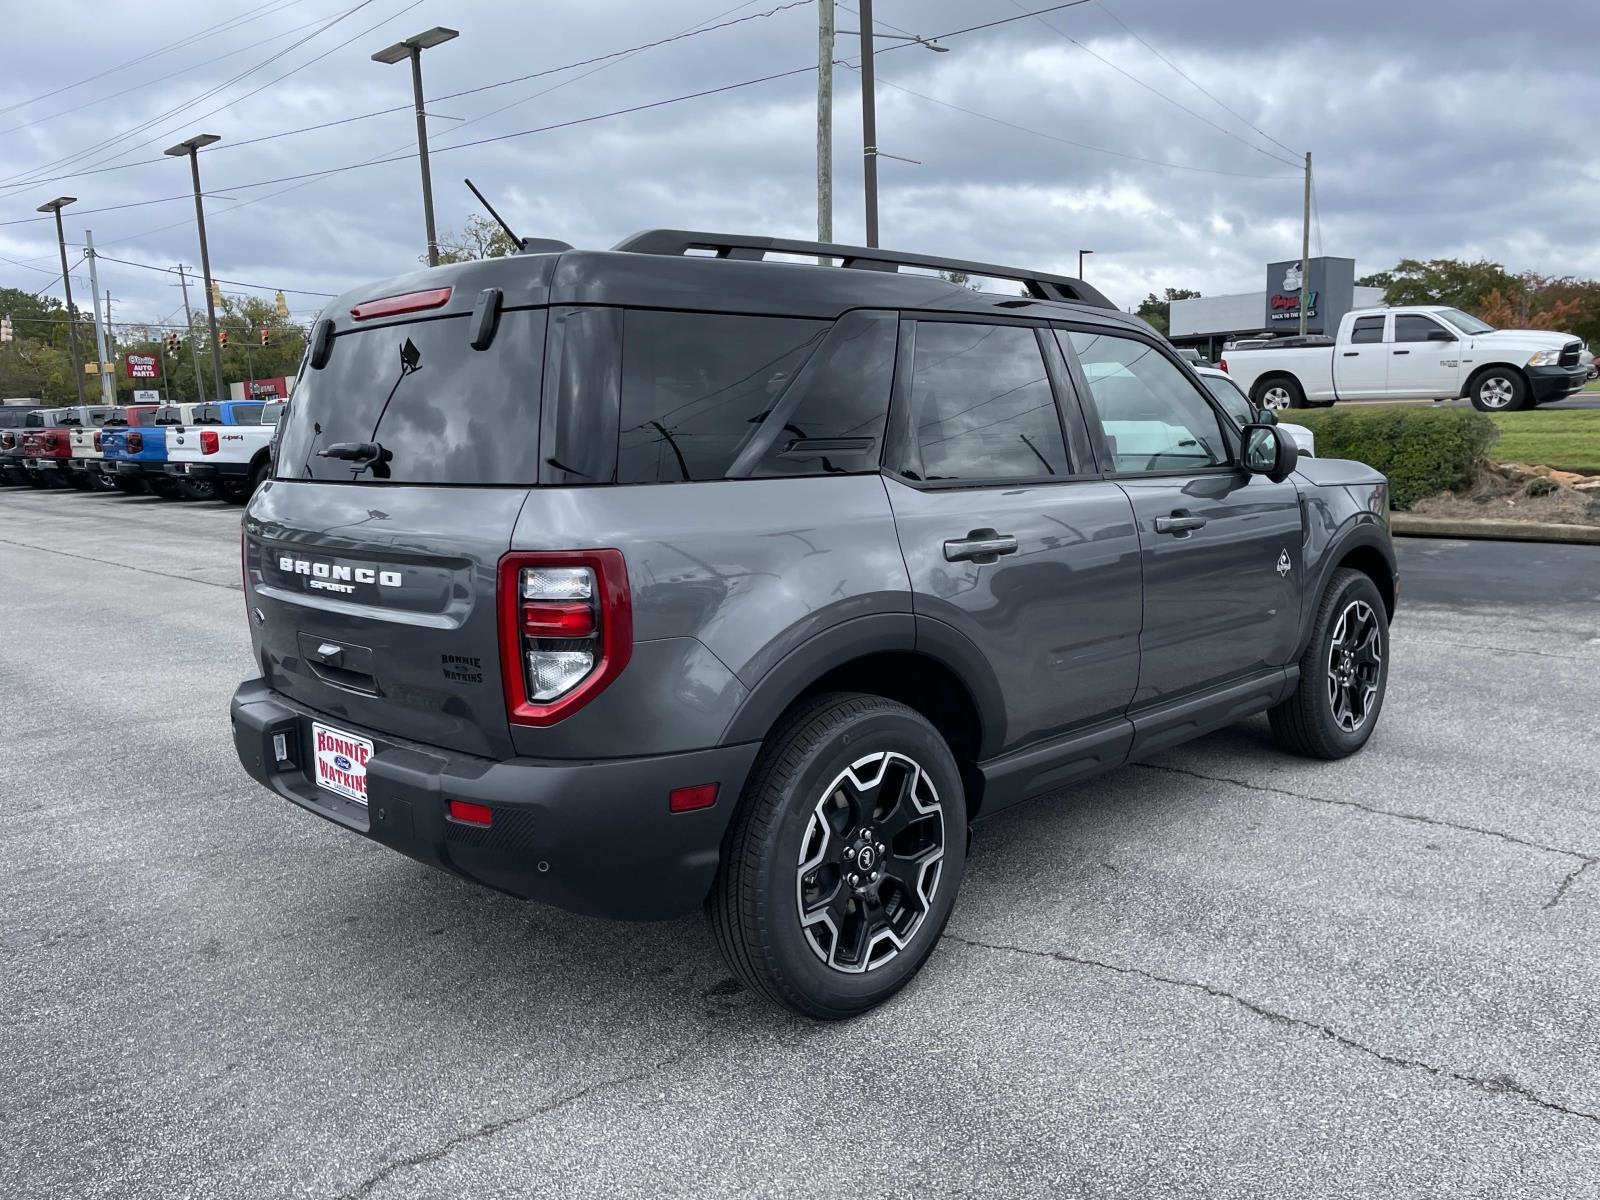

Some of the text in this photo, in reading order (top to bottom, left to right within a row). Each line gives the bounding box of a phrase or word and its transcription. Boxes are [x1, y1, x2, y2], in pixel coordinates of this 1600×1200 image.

[280, 557, 402, 587] BRONCO
[310, 580, 355, 594] SPORT
[441, 654, 481, 668] RONNIE
[442, 668, 482, 683] WATKINS
[317, 732, 368, 769] RONNIE
[336, 756, 350, 769] Ford
[318, 756, 368, 794] WATKINS
